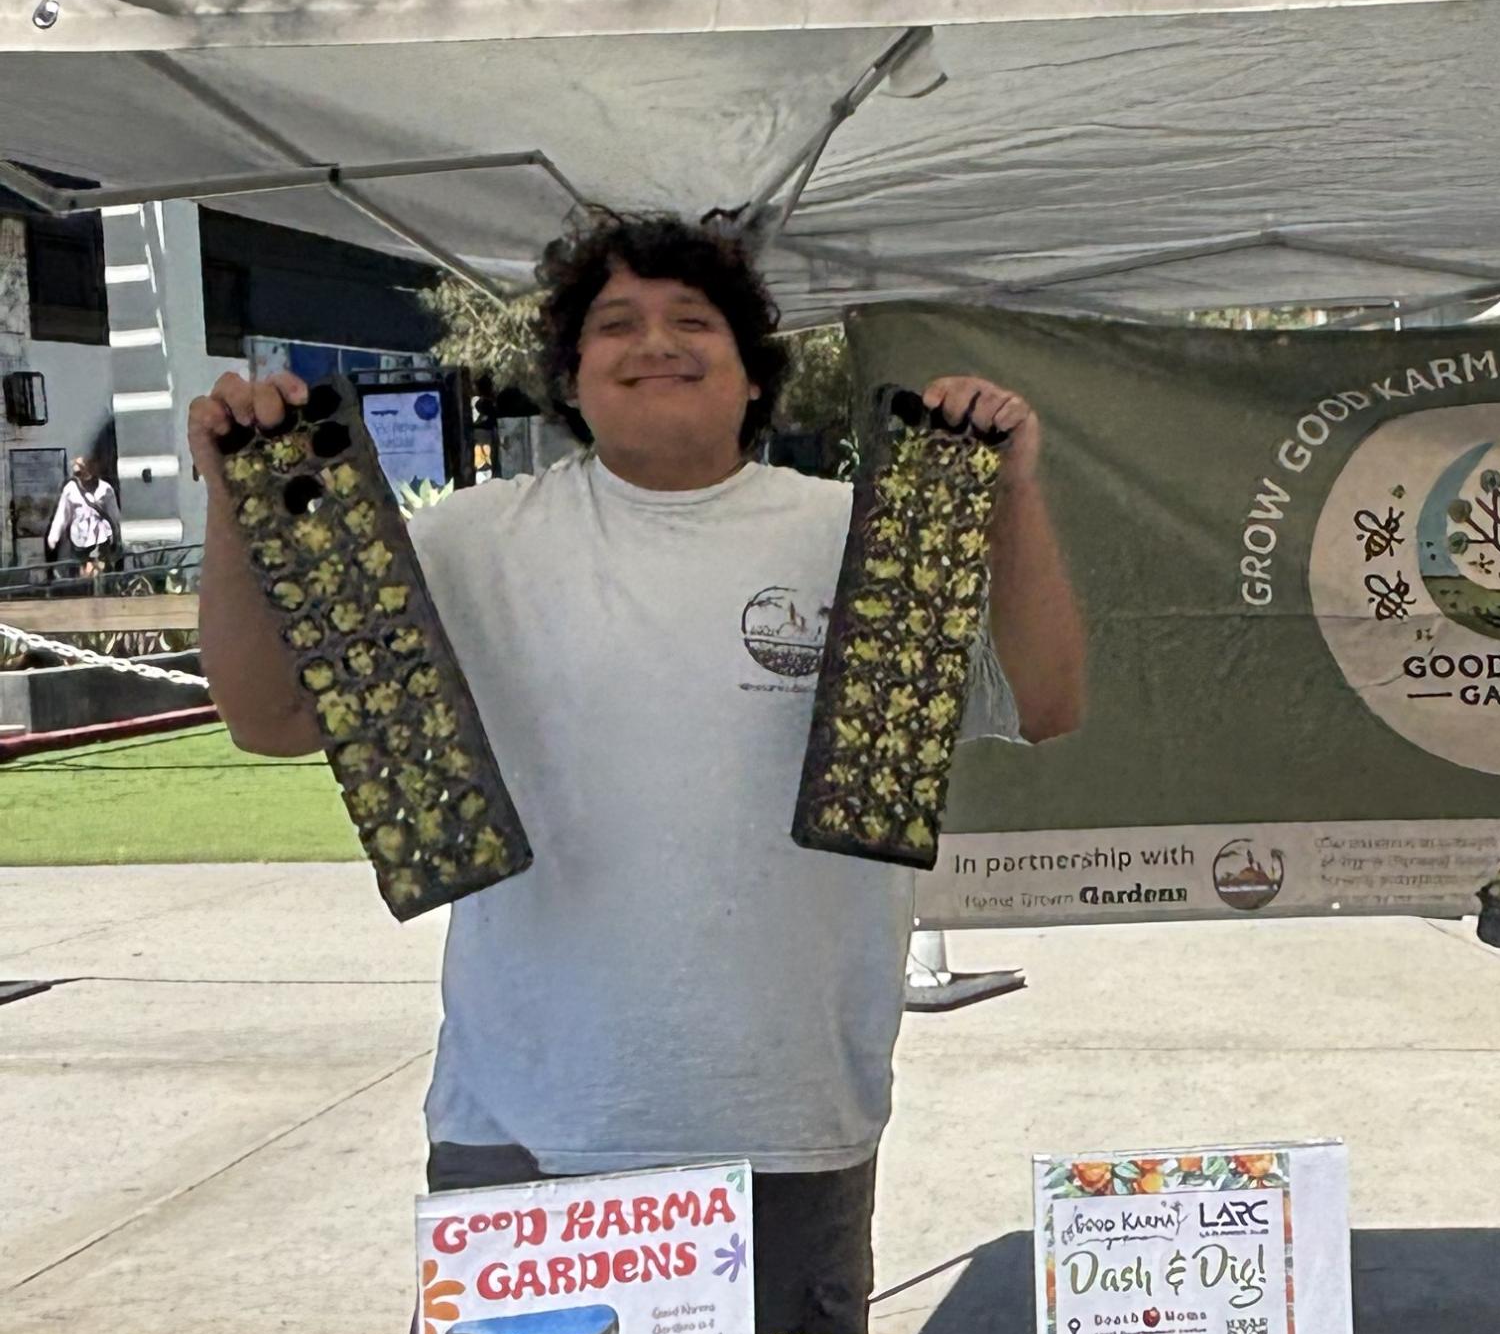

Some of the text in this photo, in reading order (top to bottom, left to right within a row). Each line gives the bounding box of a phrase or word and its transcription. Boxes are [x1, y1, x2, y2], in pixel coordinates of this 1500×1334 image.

[1239, 476, 1292, 607] GROW
[1277, 390, 1372, 473] GOOD
[954, 844, 1195, 878] In partnership with
[560, 1187, 737, 1243] KARMA
[1199, 1199, 1270, 1229] LARC
[1061, 1243, 1267, 1310] Dash & Dig!
